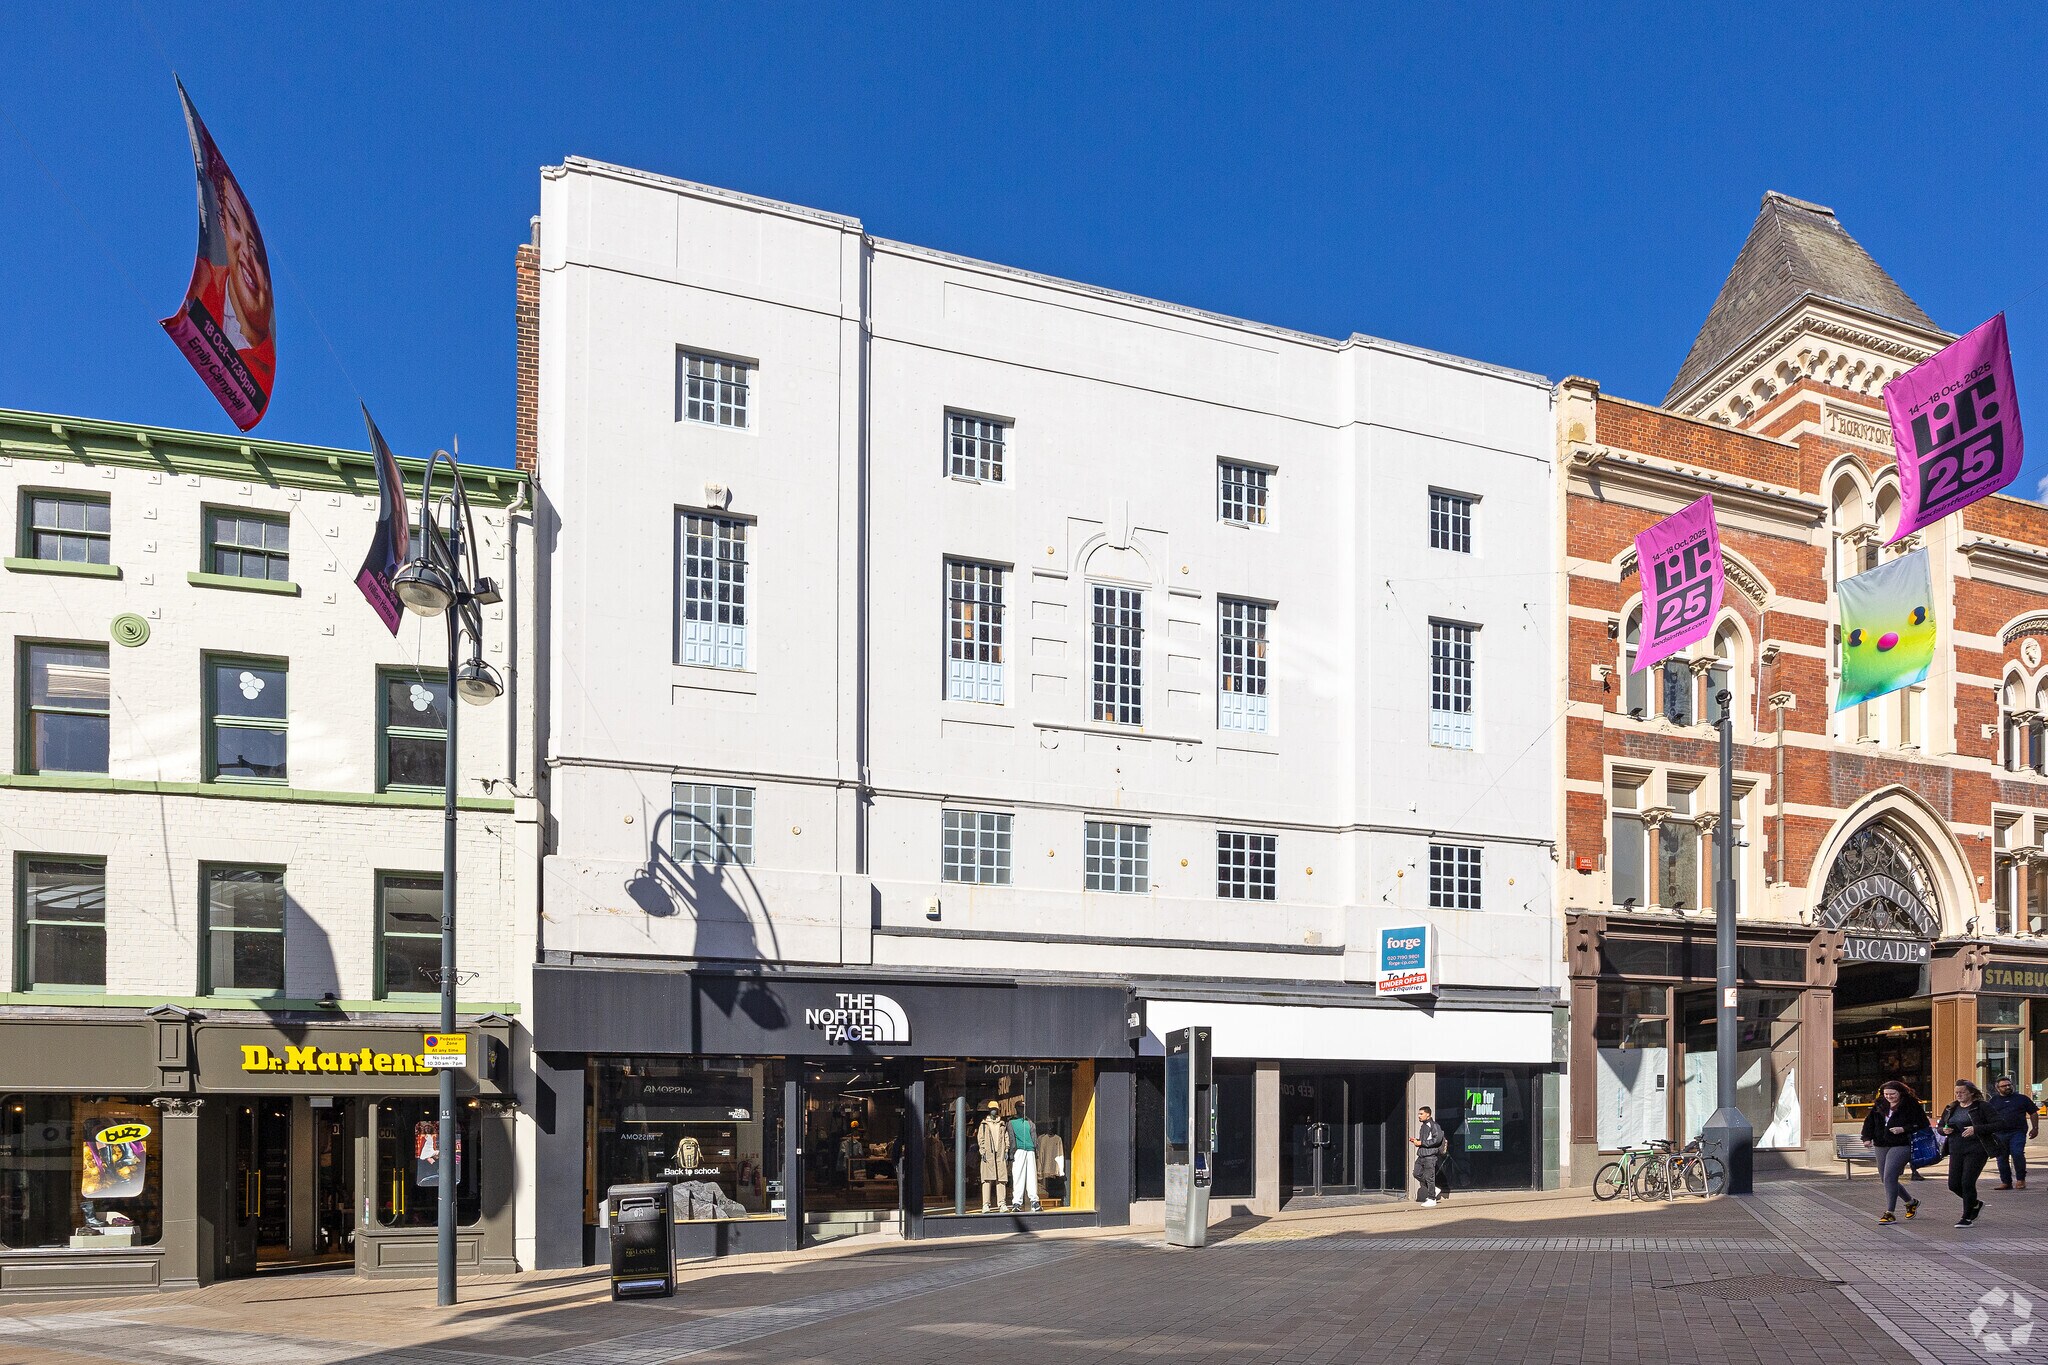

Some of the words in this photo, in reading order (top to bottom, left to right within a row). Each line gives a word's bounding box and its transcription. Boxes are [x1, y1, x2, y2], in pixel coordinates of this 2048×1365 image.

[204, 320, 212, 336] 18
[187, 336, 213, 366] Emily
[1942, 380, 1963, 397] Oct,
[1964, 362, 1991, 384] 2025
[1926, 434, 1996, 504] 25
[1674, 539, 1689, 552] Oct,
[1689, 528, 1707, 544] 2025
[1660, 584, 1706, 632] 25
[1822, 874, 1935, 934] THORNTON'S
[1386, 937, 1420, 950] forge
[1842, 940, 1920, 962] ARCADE
[1380, 980, 1404, 989] UNDER
[1404, 975, 1426, 984] OFFER
[1985, 968, 2048, 987] STARBU
[836, 993, 873, 1009] THE
[1649, 1005, 1658, 1014] 78
[806, 1008, 873, 1025] NORTH
[826, 1025, 874, 1042] FACE
[1483, 1090, 1495, 1104] for
[105, 1127, 141, 1142] buzz
